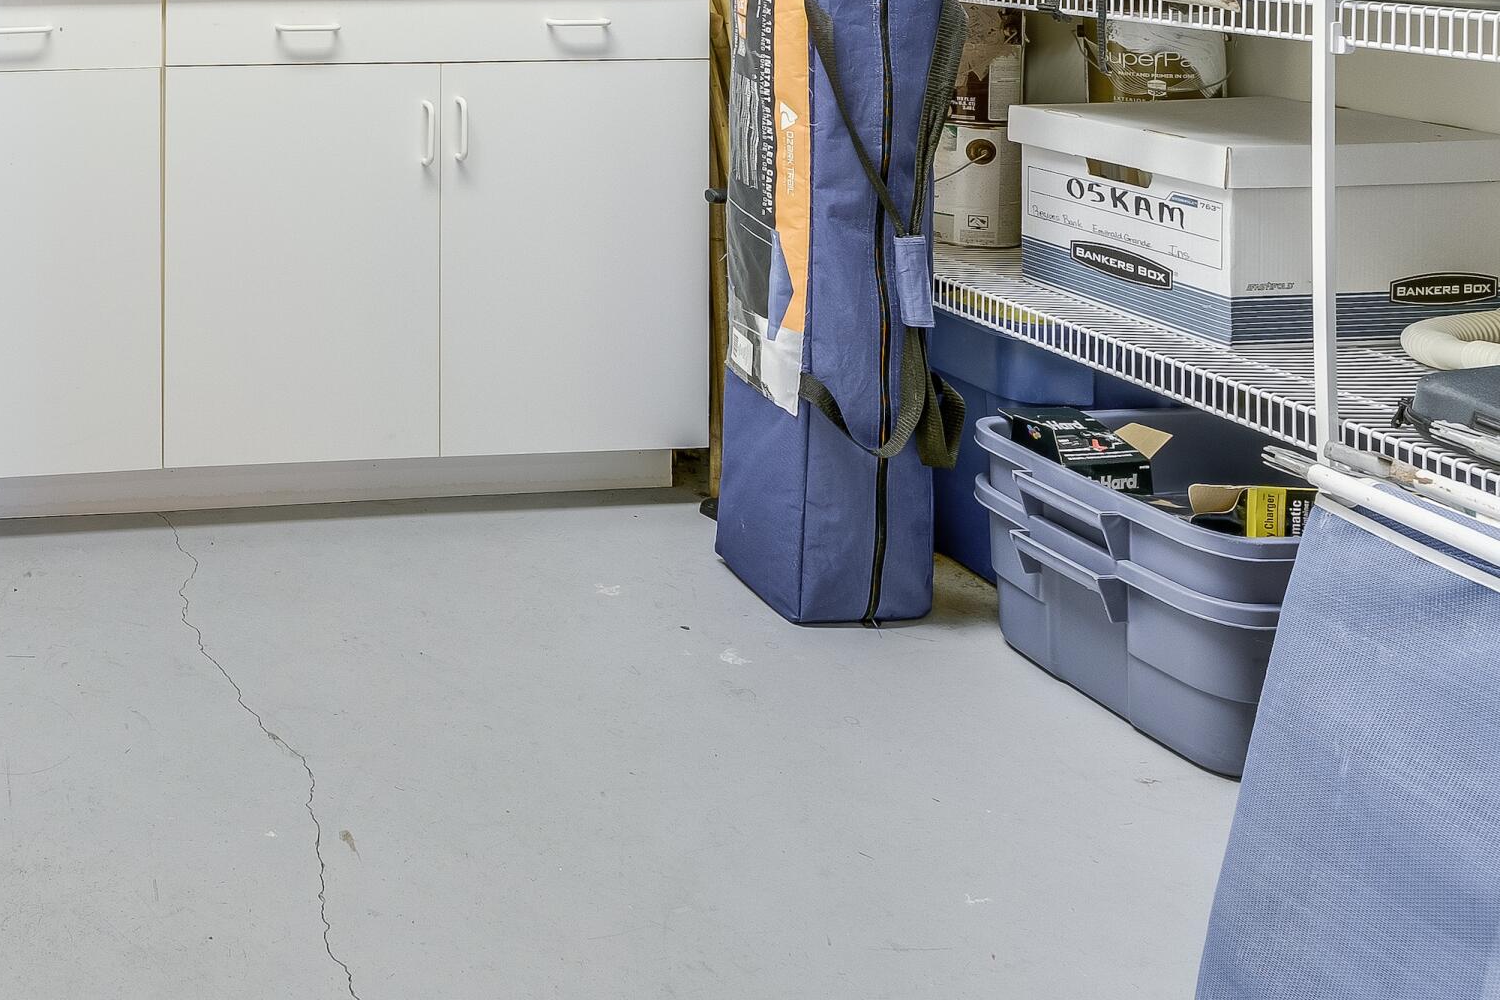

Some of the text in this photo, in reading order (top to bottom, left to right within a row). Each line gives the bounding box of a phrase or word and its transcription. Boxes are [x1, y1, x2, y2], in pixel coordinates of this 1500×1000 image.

[765, 38, 771, 51] FT
[763, 55, 772, 102] INSTANT
[766, 145, 774, 166] LEG
[765, 170, 774, 214] CANOPY
[1066, 178, 1185, 229] OSKAM
[1062, 213, 1083, 229] Bank
[1075, 247, 1166, 283] BANKERS BOX
[1396, 283, 1492, 297] BANKERS BOX
[1264, 494, 1276, 530] Charger
